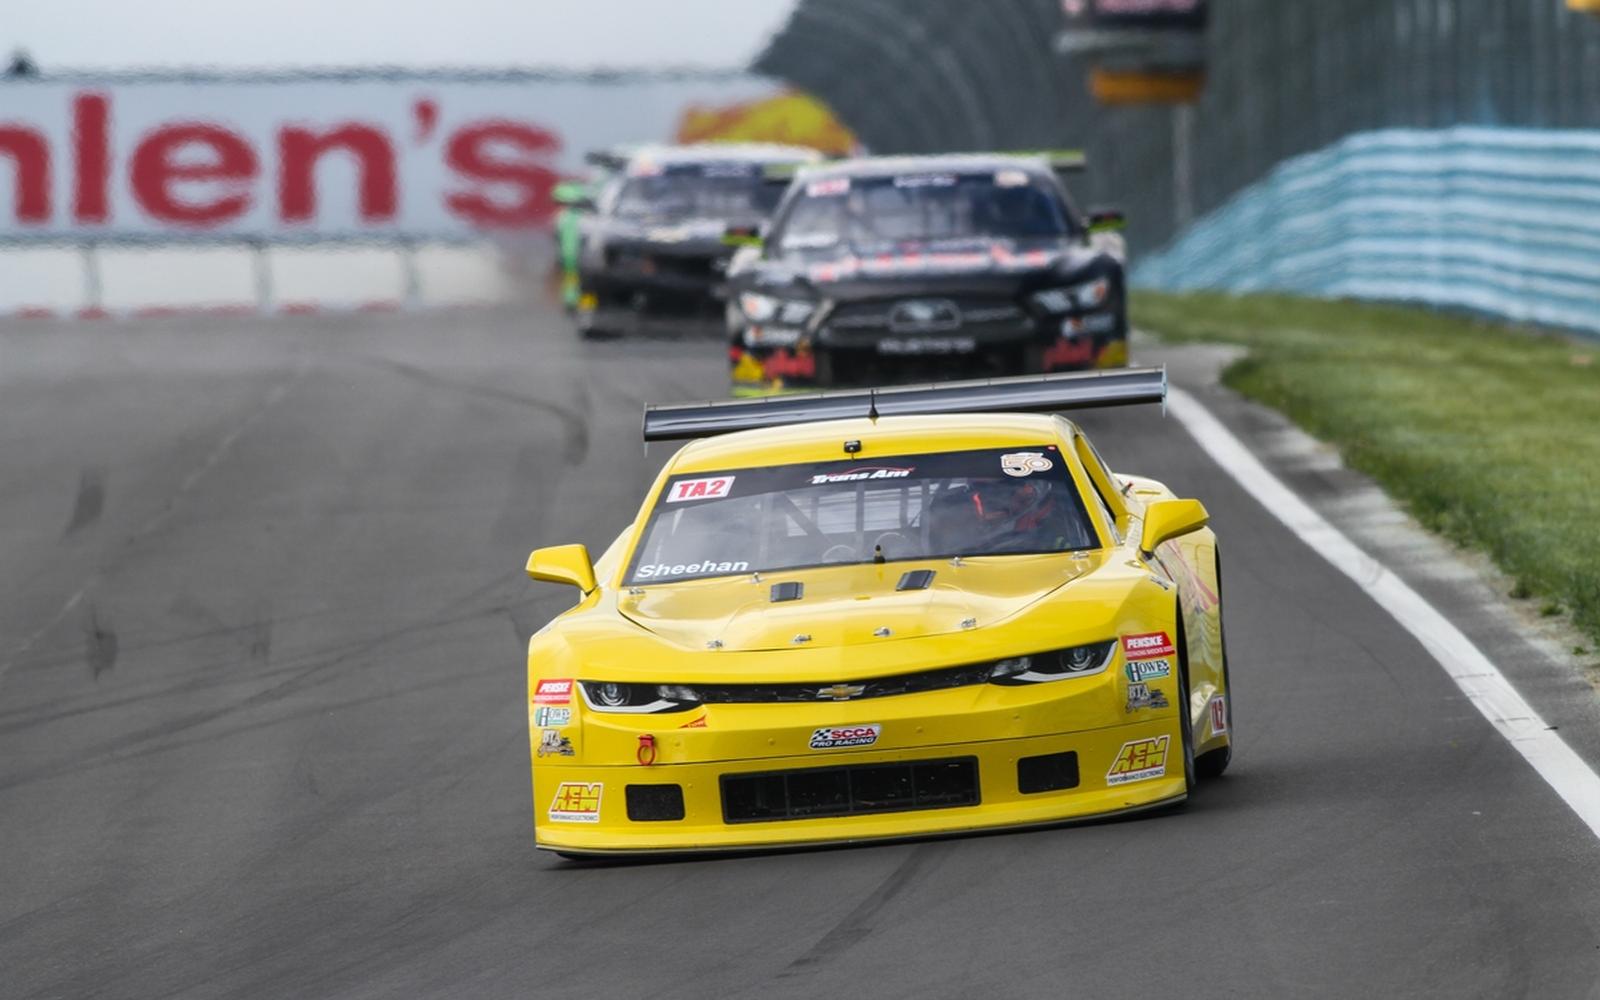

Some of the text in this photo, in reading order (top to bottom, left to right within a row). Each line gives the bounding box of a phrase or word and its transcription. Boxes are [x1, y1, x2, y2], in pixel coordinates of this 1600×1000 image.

[811, 469, 909, 484] Trans Am
[678, 480, 726, 498] TA2
[637, 560, 749, 577] Sheehan
[831, 728, 875, 739] SCCA
[834, 737, 874, 746] RACING
[1111, 738, 1168, 773] AEM
[553, 785, 600, 811] AEM
